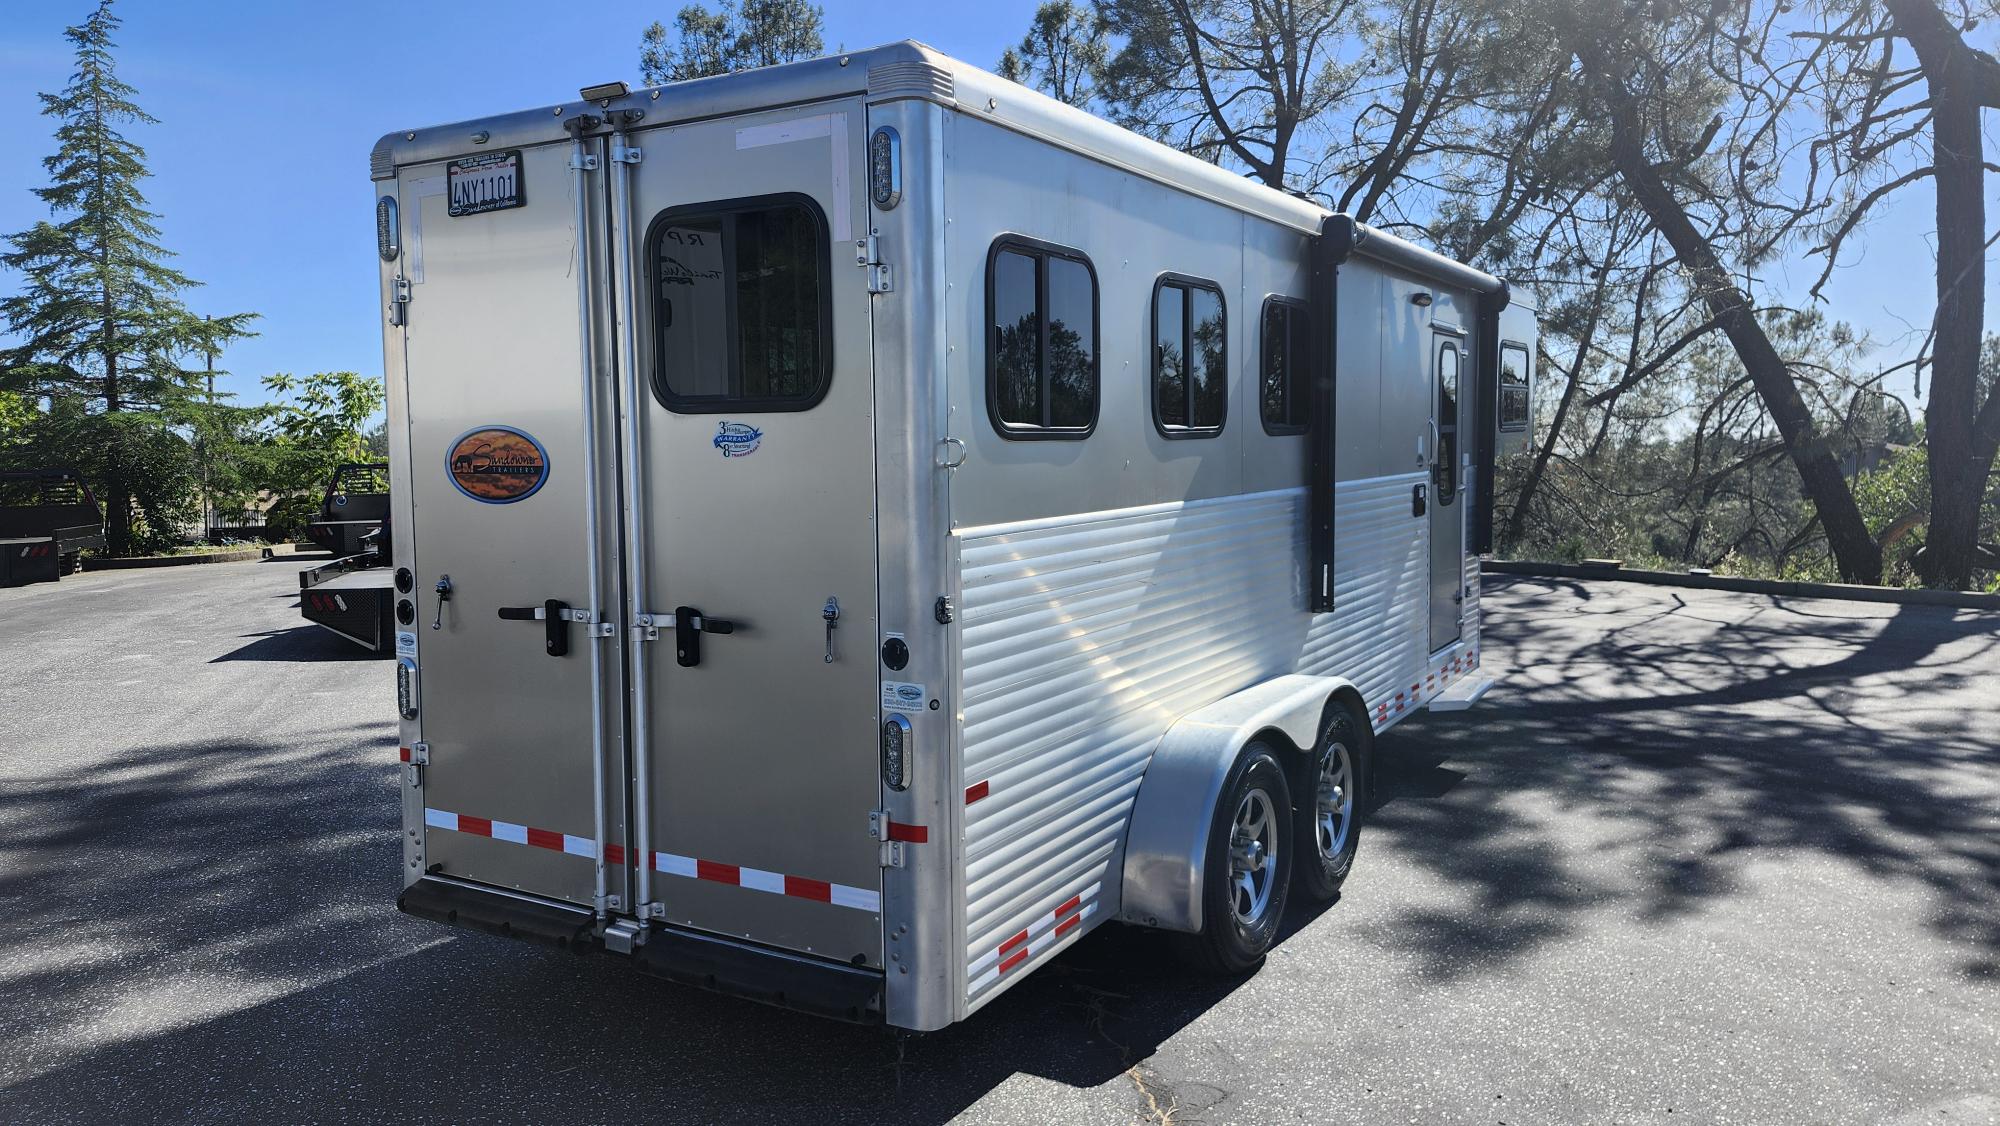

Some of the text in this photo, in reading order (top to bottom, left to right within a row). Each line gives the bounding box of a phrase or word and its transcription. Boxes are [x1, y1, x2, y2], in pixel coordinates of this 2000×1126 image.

[454, 174, 512, 206] 4NY1101
[719, 421, 727, 435] 3
[717, 431, 756, 442] WARRANTY
[473, 443, 539, 471] Sundowner
[723, 443, 730, 458] 8
[493, 466, 535, 474] TRAILERS
